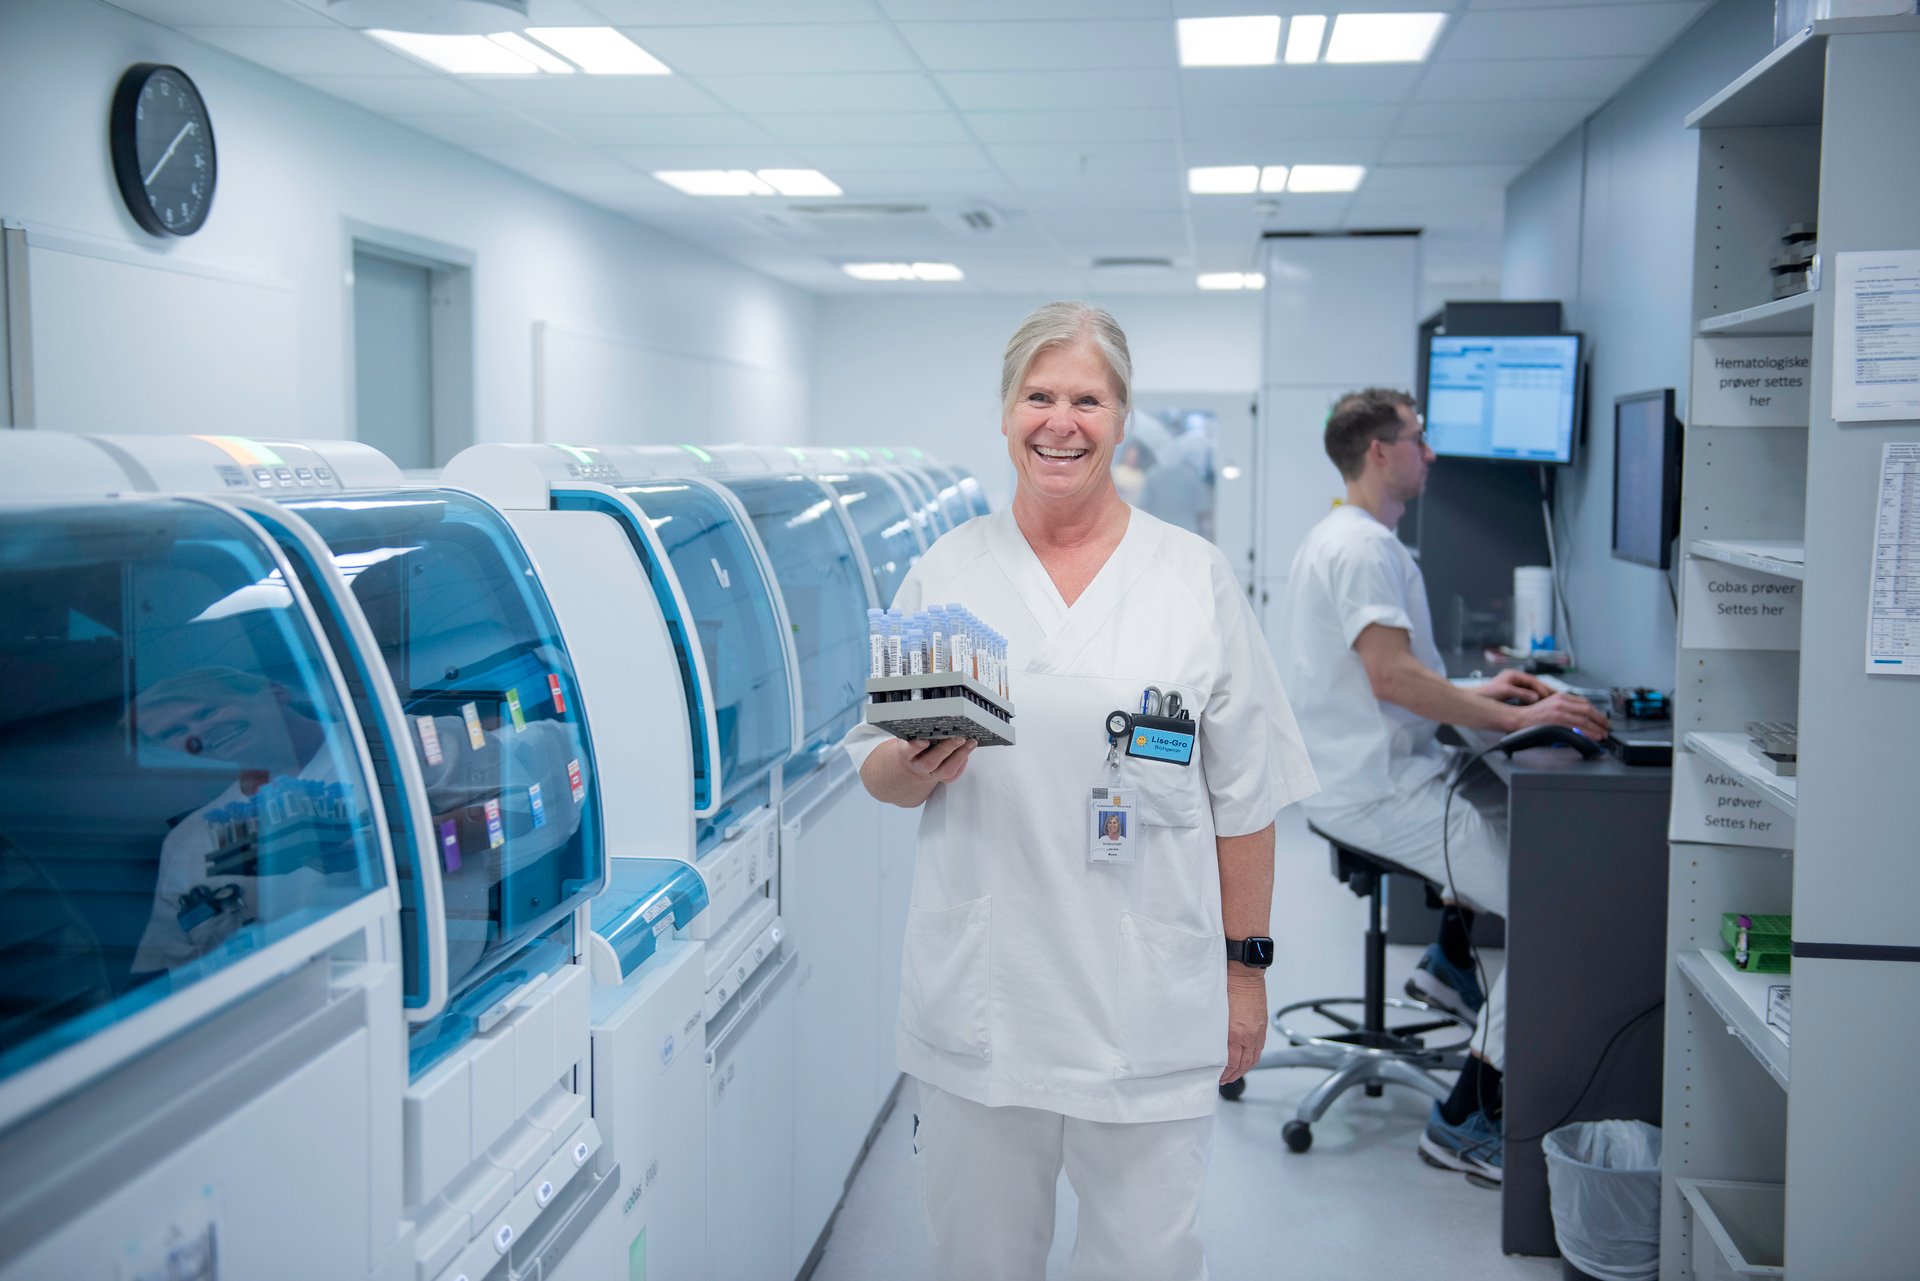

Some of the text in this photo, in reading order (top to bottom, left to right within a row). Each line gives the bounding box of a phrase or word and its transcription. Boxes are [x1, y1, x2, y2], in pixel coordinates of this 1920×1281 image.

[1715, 356, 1809, 371] Hematologiske
[1720, 376, 1803, 391] prøver settes
[1748, 394, 1772, 407] her
[1708, 580, 1796, 596] Cobas prøver
[1717, 603, 1785, 616] Settes her
[1151, 735, 1188, 748] Lise-Gro
[1718, 796, 1763, 809] prøver
[1705, 814, 1772, 831] Settes her
